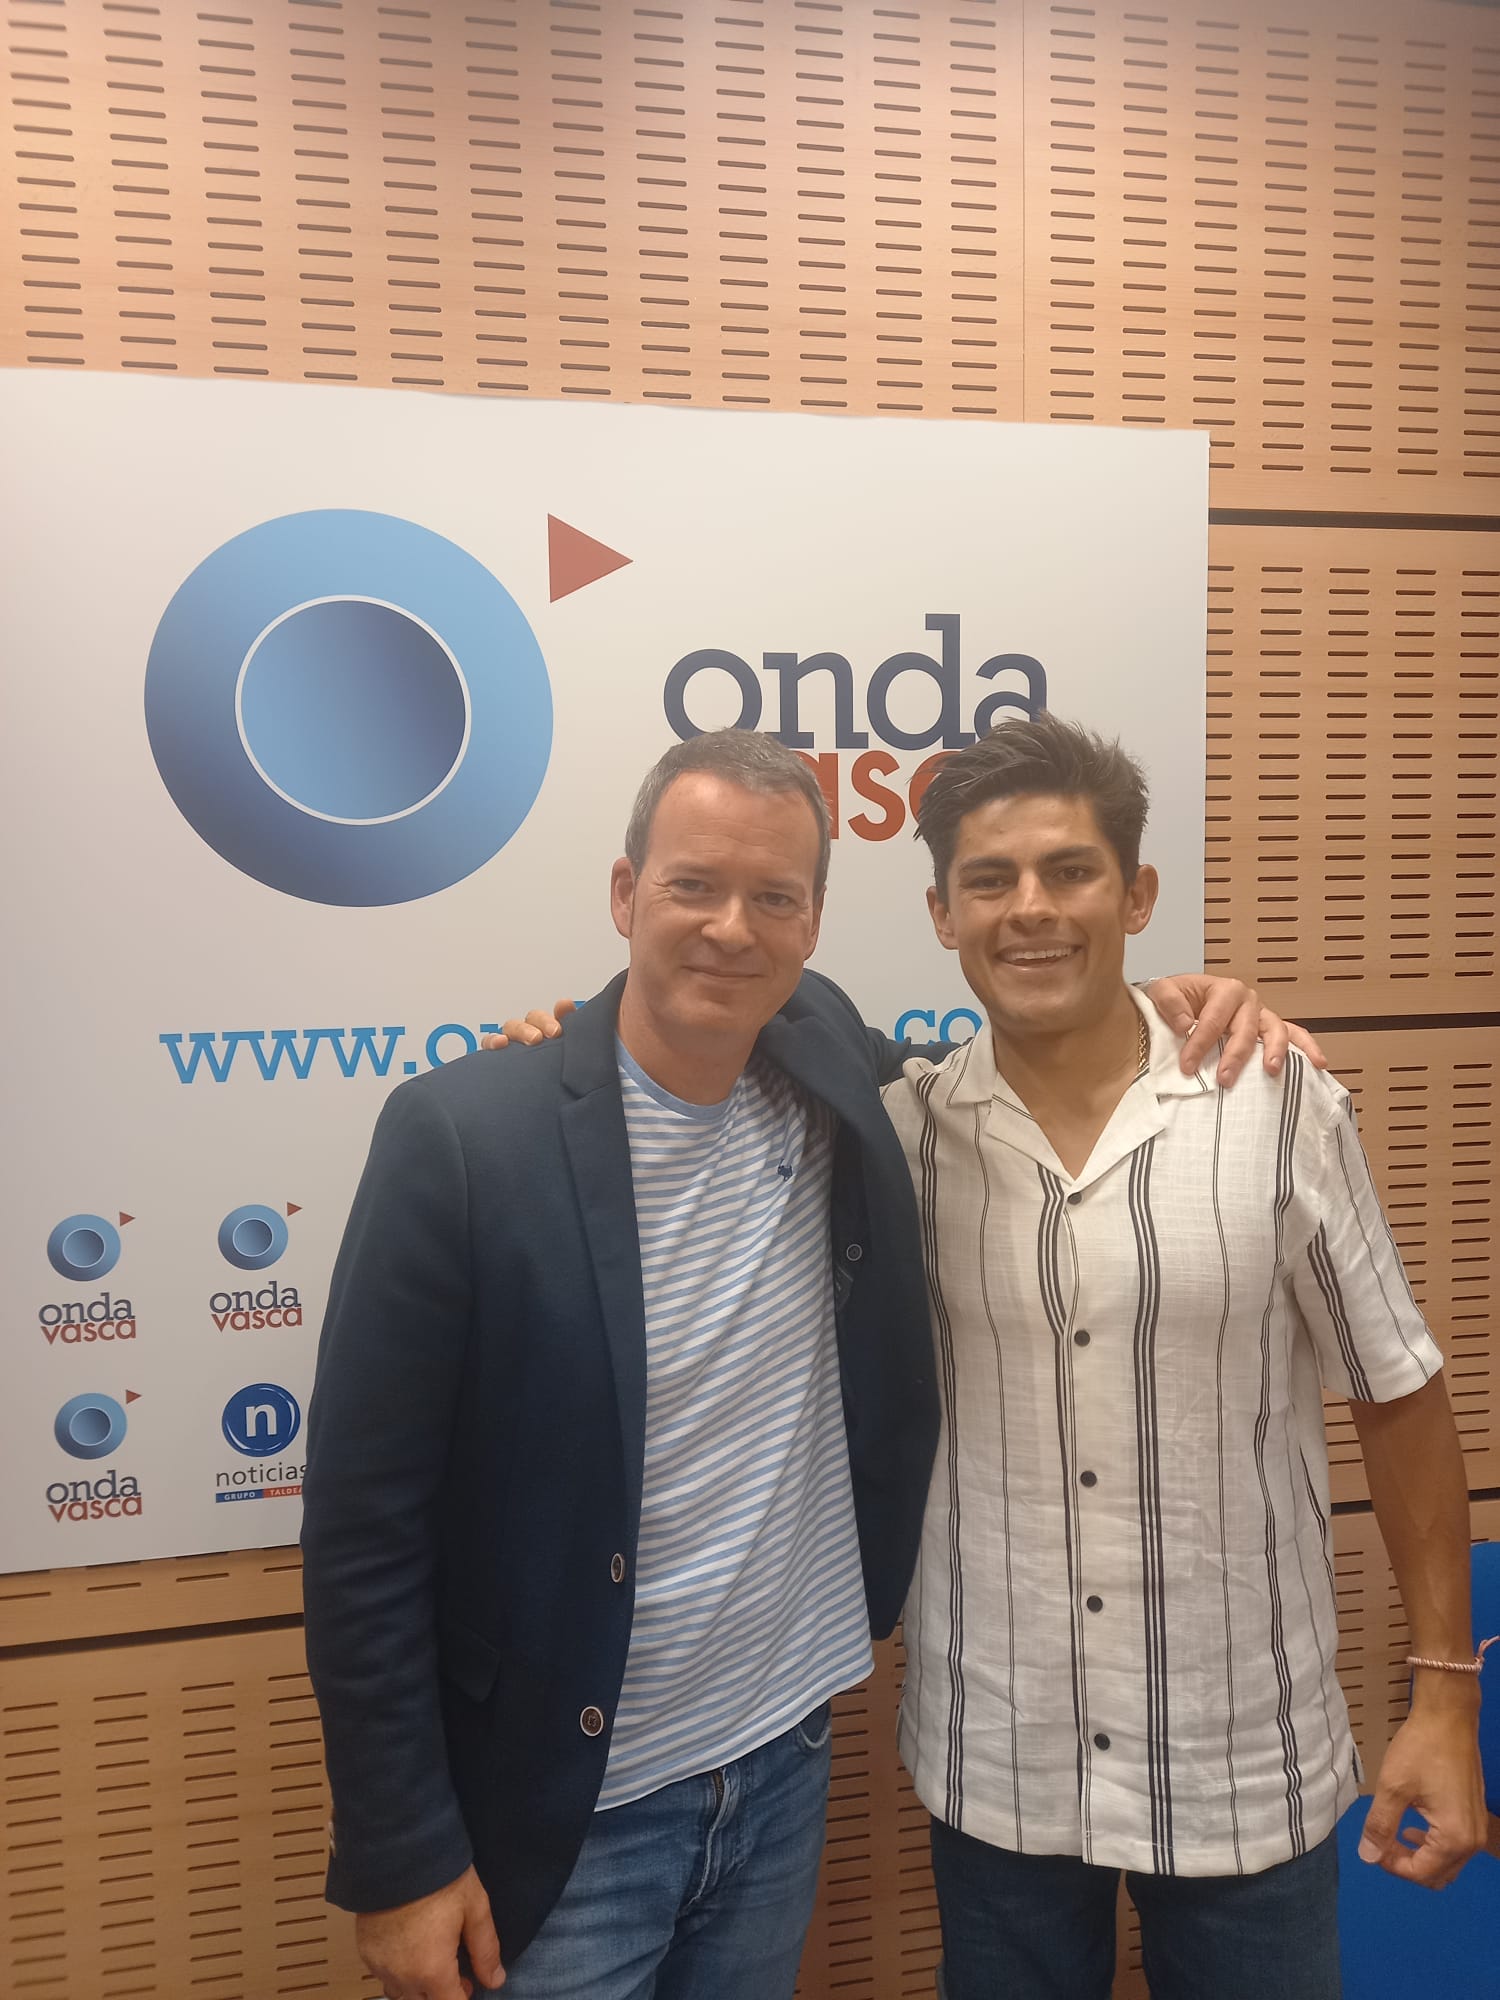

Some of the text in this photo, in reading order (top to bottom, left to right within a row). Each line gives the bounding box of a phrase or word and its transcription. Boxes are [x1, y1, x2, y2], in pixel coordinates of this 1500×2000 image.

[663, 613, 1048, 751] onda
[38, 1292, 136, 1326] onda
[209, 1280, 302, 1314] onda
[40, 1319, 137, 1345] vasca
[211, 1307, 303, 1333] vasca
[245, 1403, 278, 1438] n
[46, 1470, 142, 1504] onda
[224, 1491, 256, 1501] GRUPO
[48, 1496, 143, 1523] vasca
